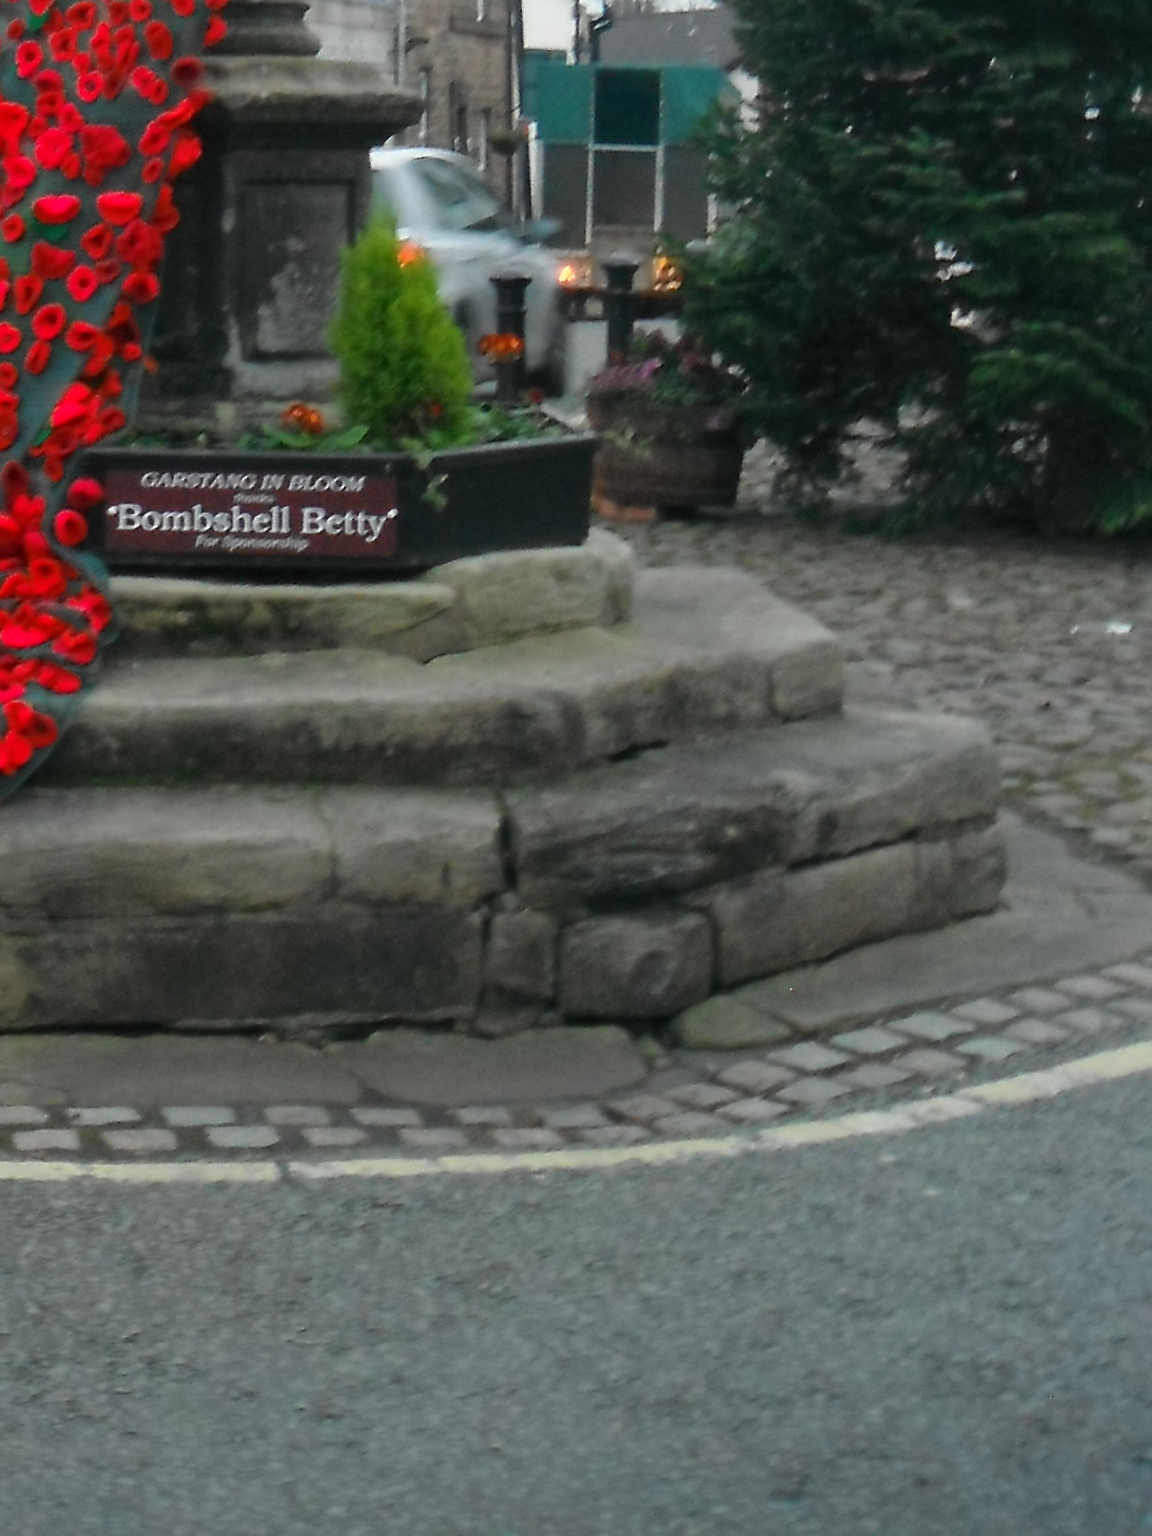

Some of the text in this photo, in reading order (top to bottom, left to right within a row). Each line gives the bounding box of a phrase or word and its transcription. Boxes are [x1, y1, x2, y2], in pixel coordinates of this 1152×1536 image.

[140, 471, 367, 492] GARSTANG IN BLOOM
[116, 503, 390, 543] Bombshell Betty
